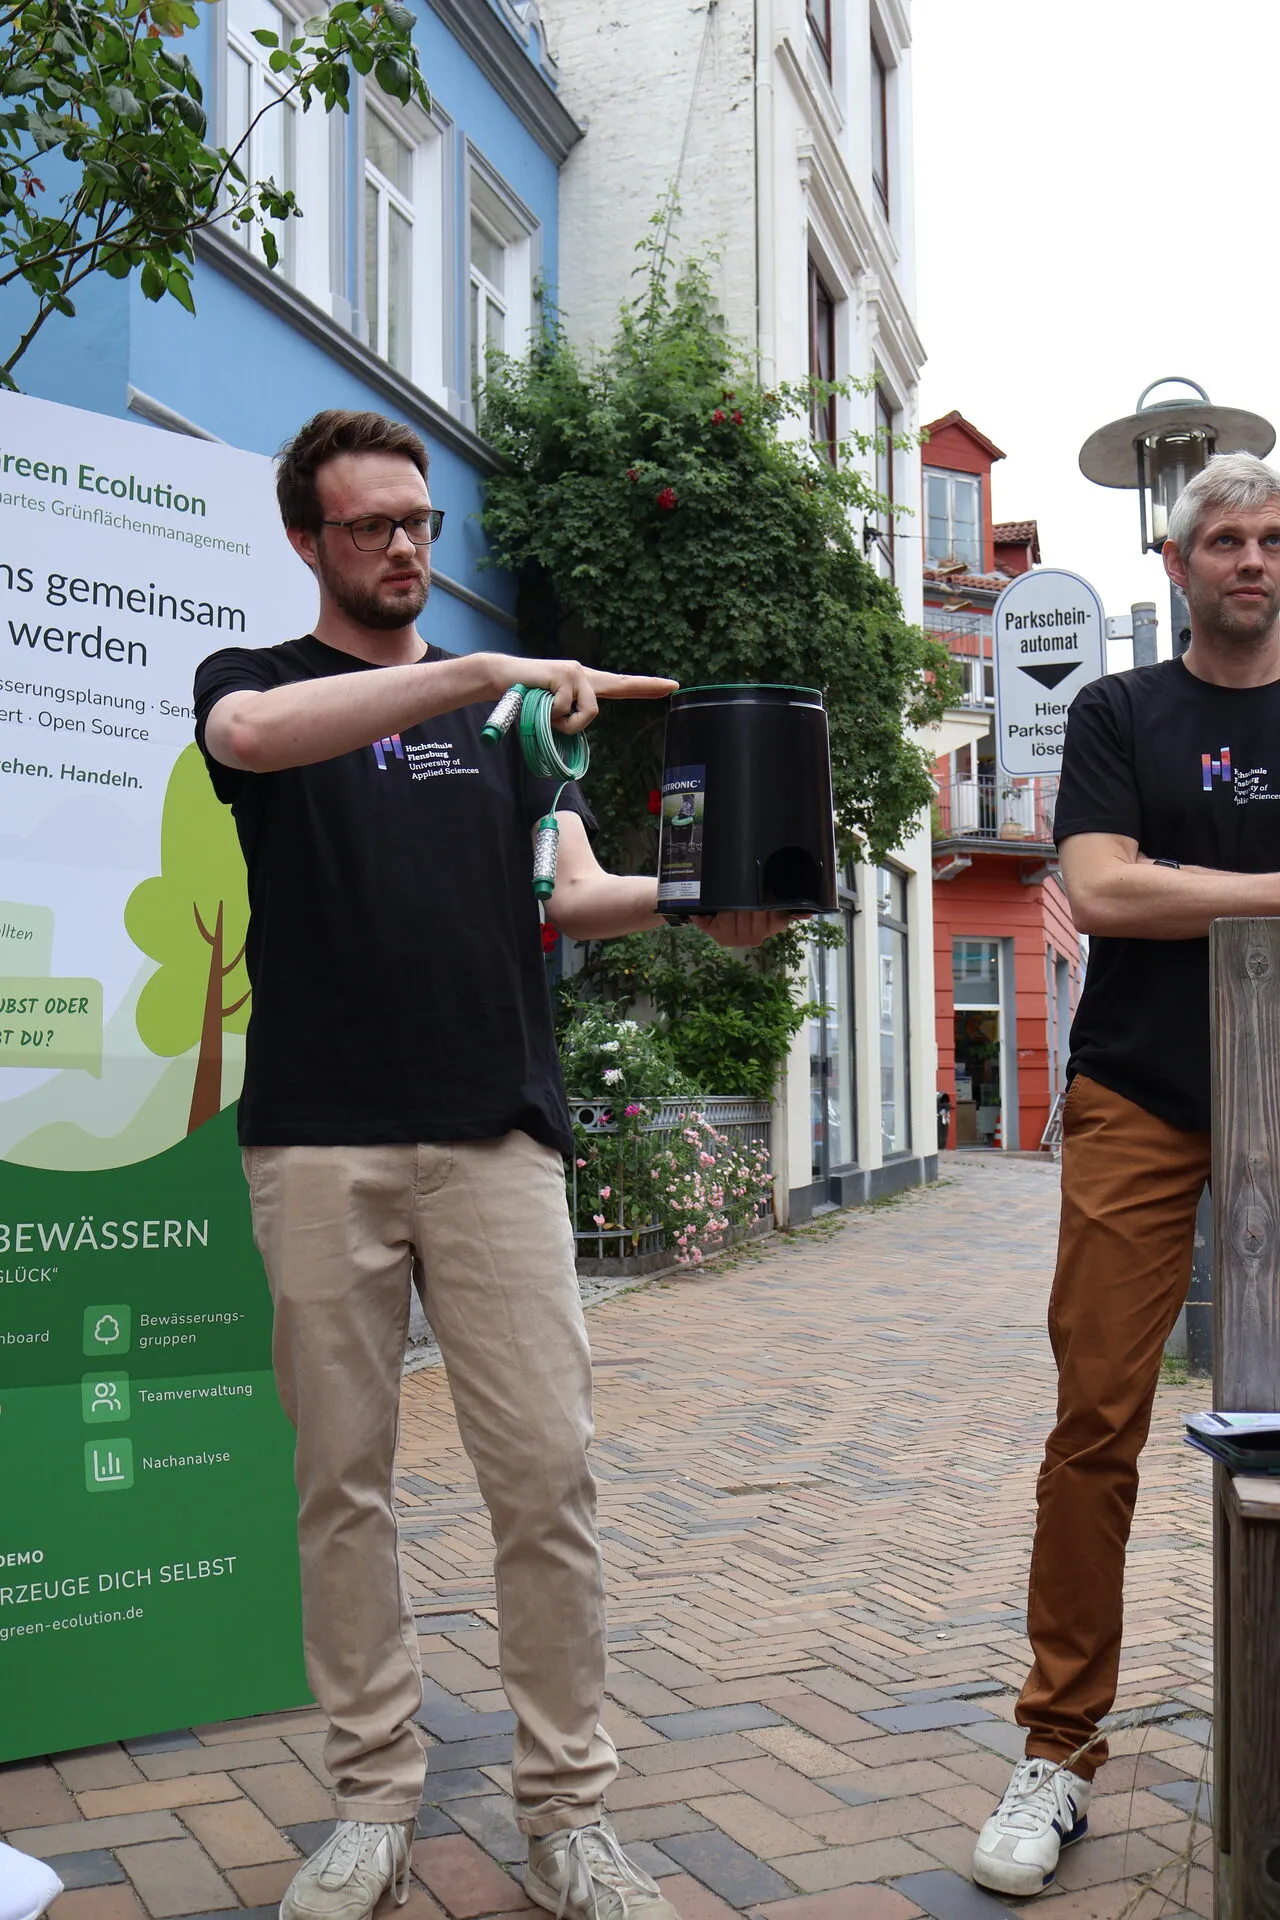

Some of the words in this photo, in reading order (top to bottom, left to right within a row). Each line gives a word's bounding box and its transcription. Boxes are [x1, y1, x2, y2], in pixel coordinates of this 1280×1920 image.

[0, 448, 68, 486] reen
[78, 464, 206, 517] Ecolution
[0, 491, 46, 512] artes
[51, 500, 250, 556] Grünflächenmanagement
[46, 573, 246, 633] gemeinsam
[1005, 607, 1091, 631] Parkschein-
[7, 620, 147, 667] werden
[1021, 632, 1078, 653] automat
[1035, 702, 1068, 716] Hier
[38, 711, 85, 732] Open
[91, 719, 149, 741] Source
[405, 742, 453, 752] Hochschule
[407, 751, 449, 761] Flensburg
[0, 758, 53, 779] ehen.
[60, 763, 143, 789] Handeln.
[409, 760, 451, 770] University
[412, 768, 443, 780] Applied
[0, 923, 33, 941] llten
[44, 997, 89, 1015] ODER
[20, 1029, 54, 1047] DU?
[140, 1311, 245, 1328] Bewässerungs-
[139, 1333, 197, 1349] gruppen
[138, 1383, 253, 1403] Teamverwaltung
[142, 1449, 231, 1470] Nachanalyse
[0, 1576, 90, 1606] RZEUGE
[98, 1568, 152, 1592] DICH
[160, 1556, 237, 1584] SELBST
[0, 1606, 144, 1642] green-ecolution.de
